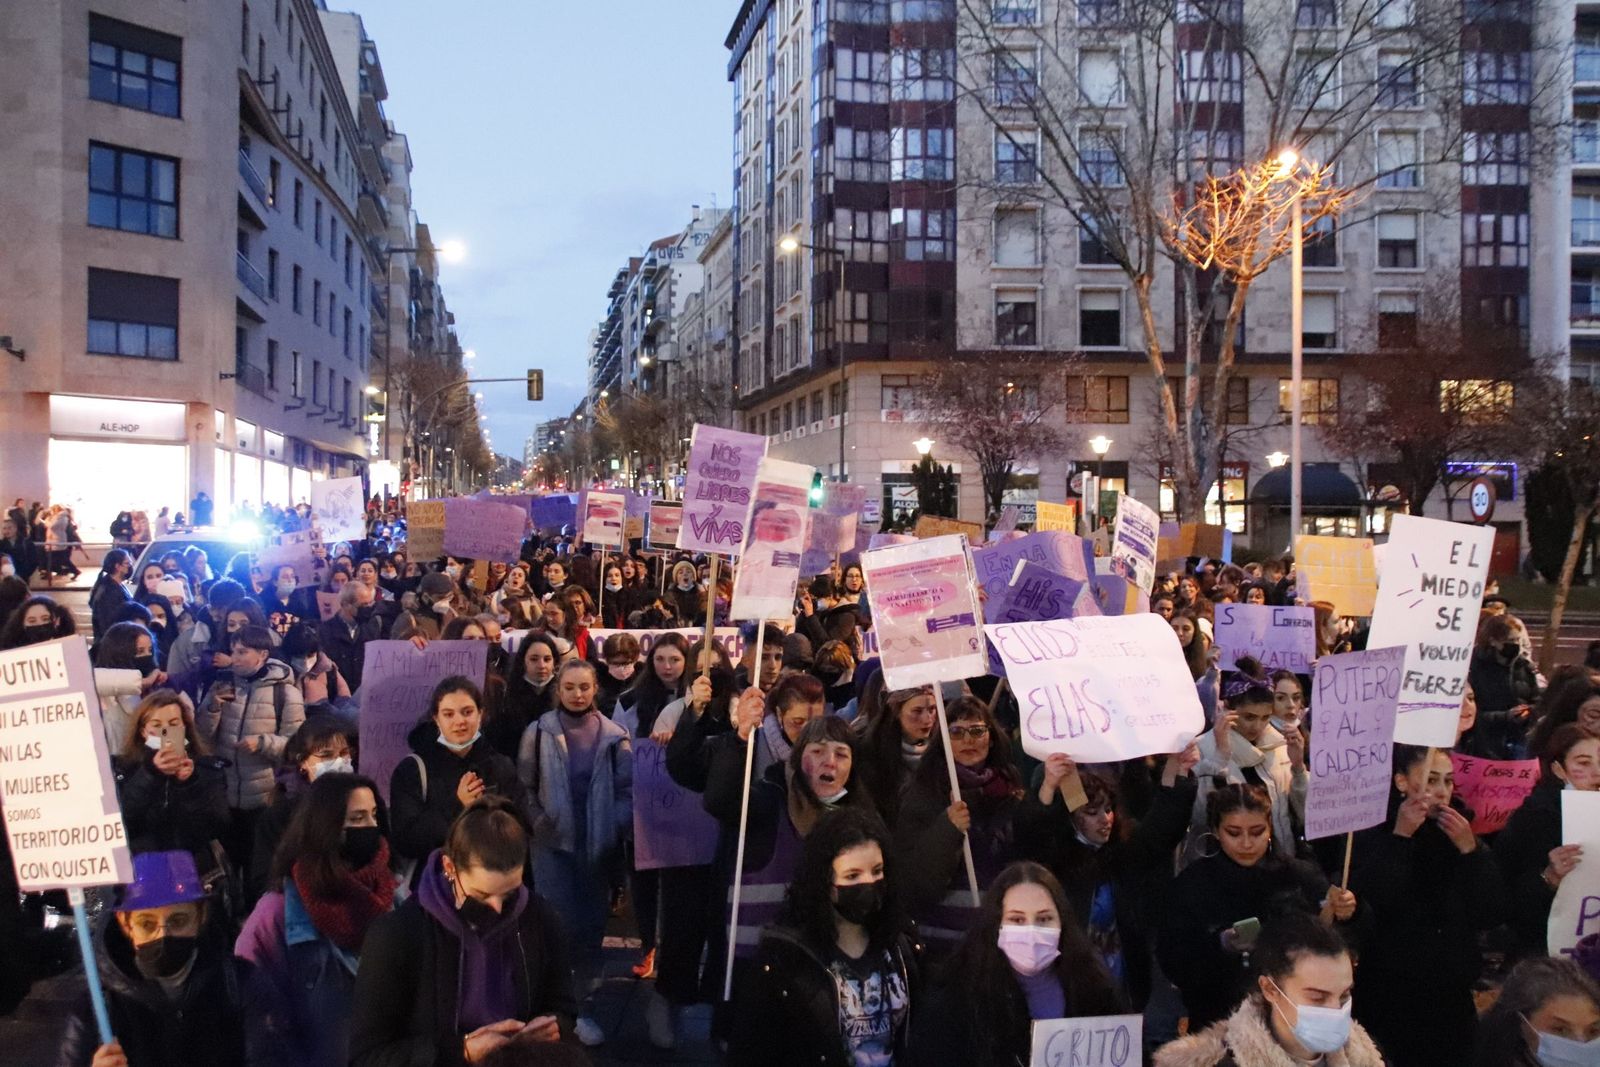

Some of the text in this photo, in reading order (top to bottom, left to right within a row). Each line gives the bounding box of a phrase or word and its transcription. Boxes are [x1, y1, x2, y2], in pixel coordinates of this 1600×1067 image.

[100, 422, 140, 432] ALE-HOP
[1474, 492, 1487, 507] 30
[1421, 572, 1482, 599] MIEDO
[1435, 606, 1464, 632] SE
[0, 657, 51, 685] UTIN
[1319, 664, 1401, 705] PUTERO
[1402, 670, 1465, 697] FUERZ
[12, 709, 29, 727] LA
[32, 701, 86, 724] TIERRA
[1336, 710, 1368, 740] AL
[17, 742, 42, 761] LAS
[1314, 742, 1389, 778] CALDERO
[5, 773, 70, 796] MUJERES
[7, 808, 41, 822] SOMOS
[12, 822, 123, 850] TERRITORIO DE
[1044, 1024, 1131, 1067] GRITO
